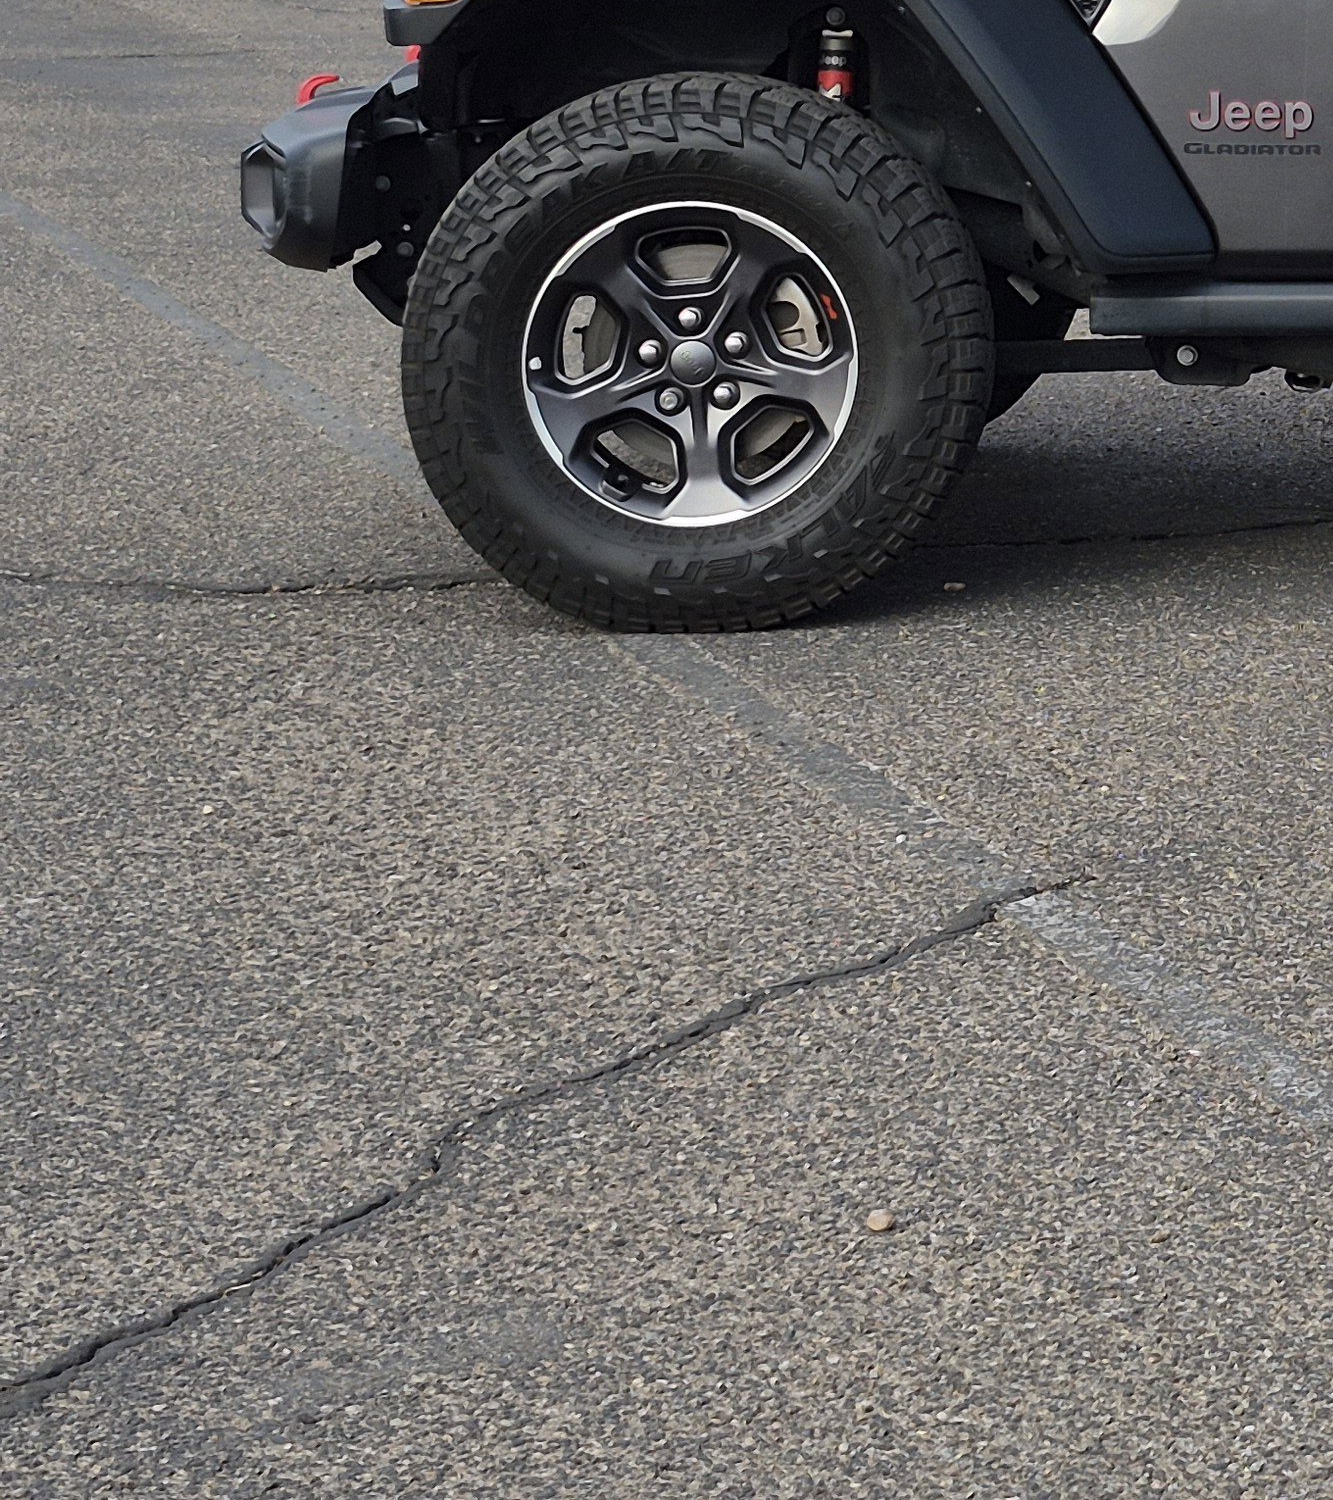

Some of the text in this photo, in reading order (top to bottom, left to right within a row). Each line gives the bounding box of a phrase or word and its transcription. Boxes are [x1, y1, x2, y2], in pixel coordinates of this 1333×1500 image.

[1189, 90, 1314, 139] Jeep
[619, 149, 732, 178] A/T
[1184, 142, 1322, 156] GLADIATOR
